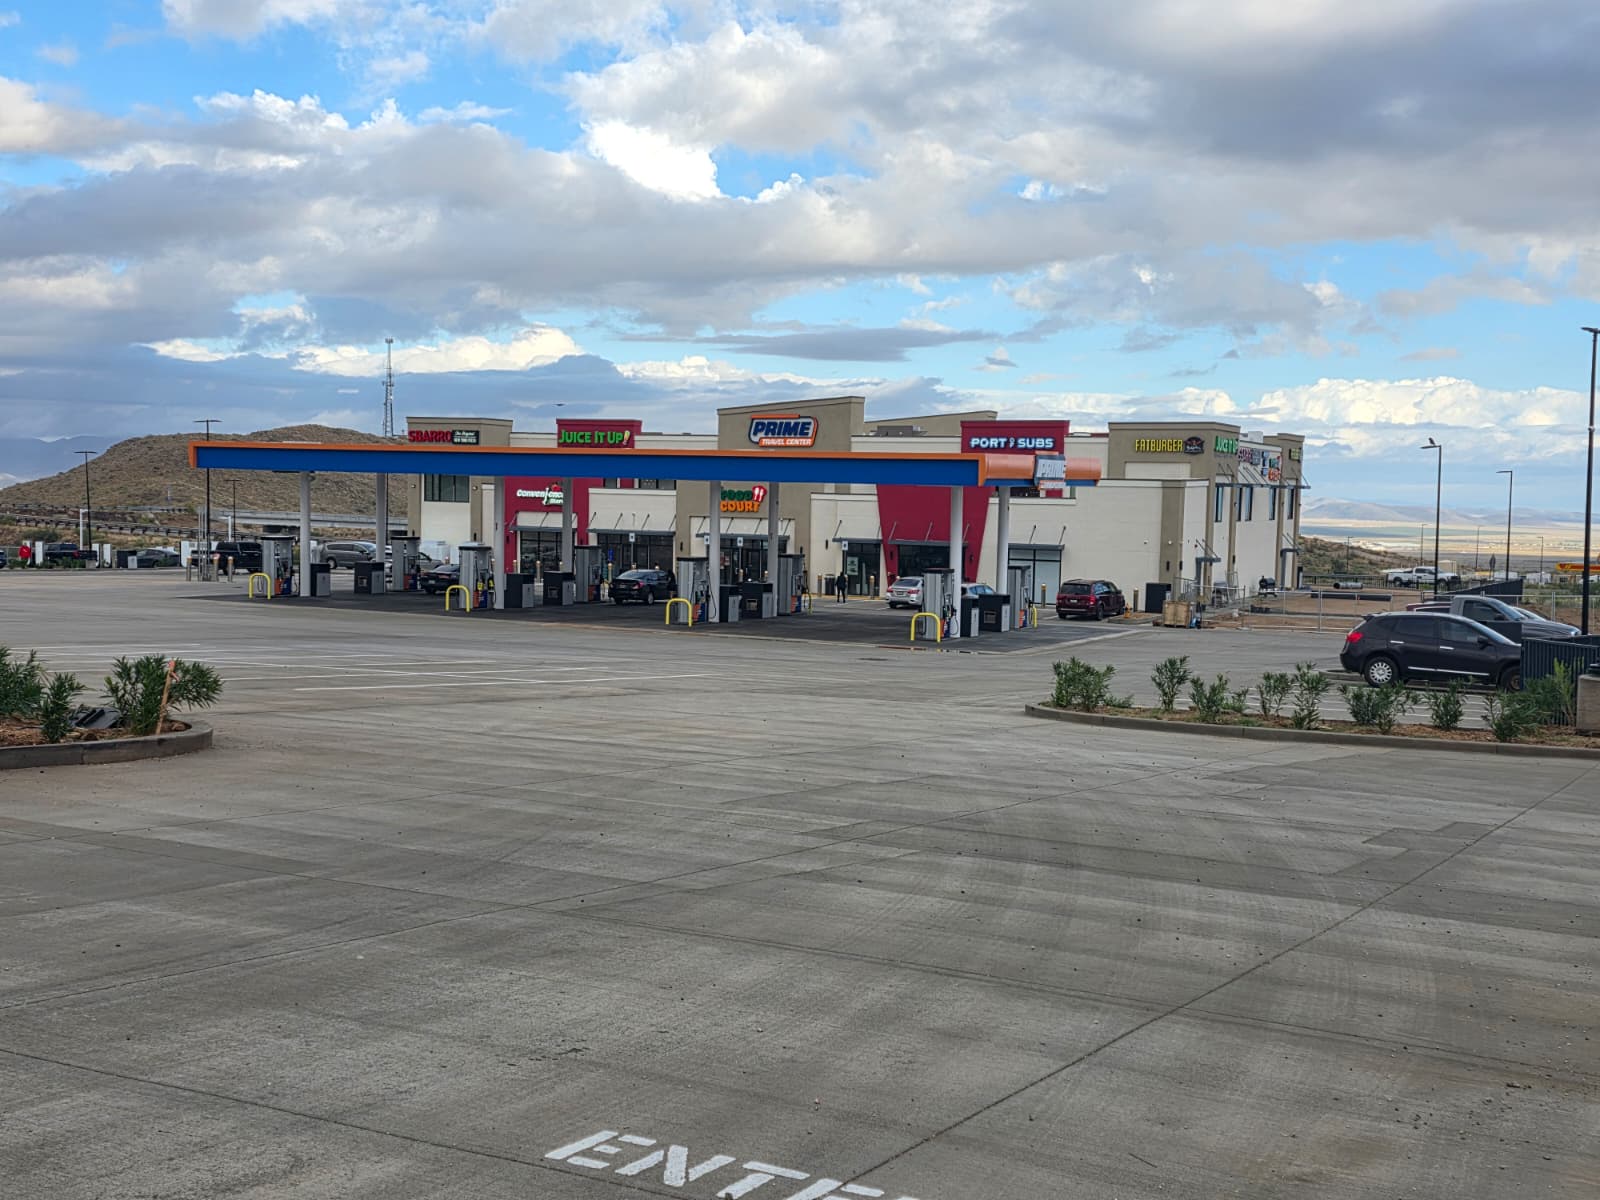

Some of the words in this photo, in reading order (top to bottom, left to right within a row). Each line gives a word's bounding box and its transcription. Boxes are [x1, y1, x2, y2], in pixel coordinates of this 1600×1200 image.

[753, 421, 812, 436] PRIME
[408, 430, 452, 443] SBARRO
[558, 429, 592, 444] JUICE
[594, 430, 606, 444] IT
[762, 438, 785, 446] TRAVEL
[786, 438, 812, 446] CENTER
[970, 437, 1007, 448] PORT
[1017, 437, 1054, 449] SUBS
[1135, 439, 1183, 452] FATBURGER
[720, 500, 760, 513] COURT
[544, 1129, 919, 1200] ENTE
